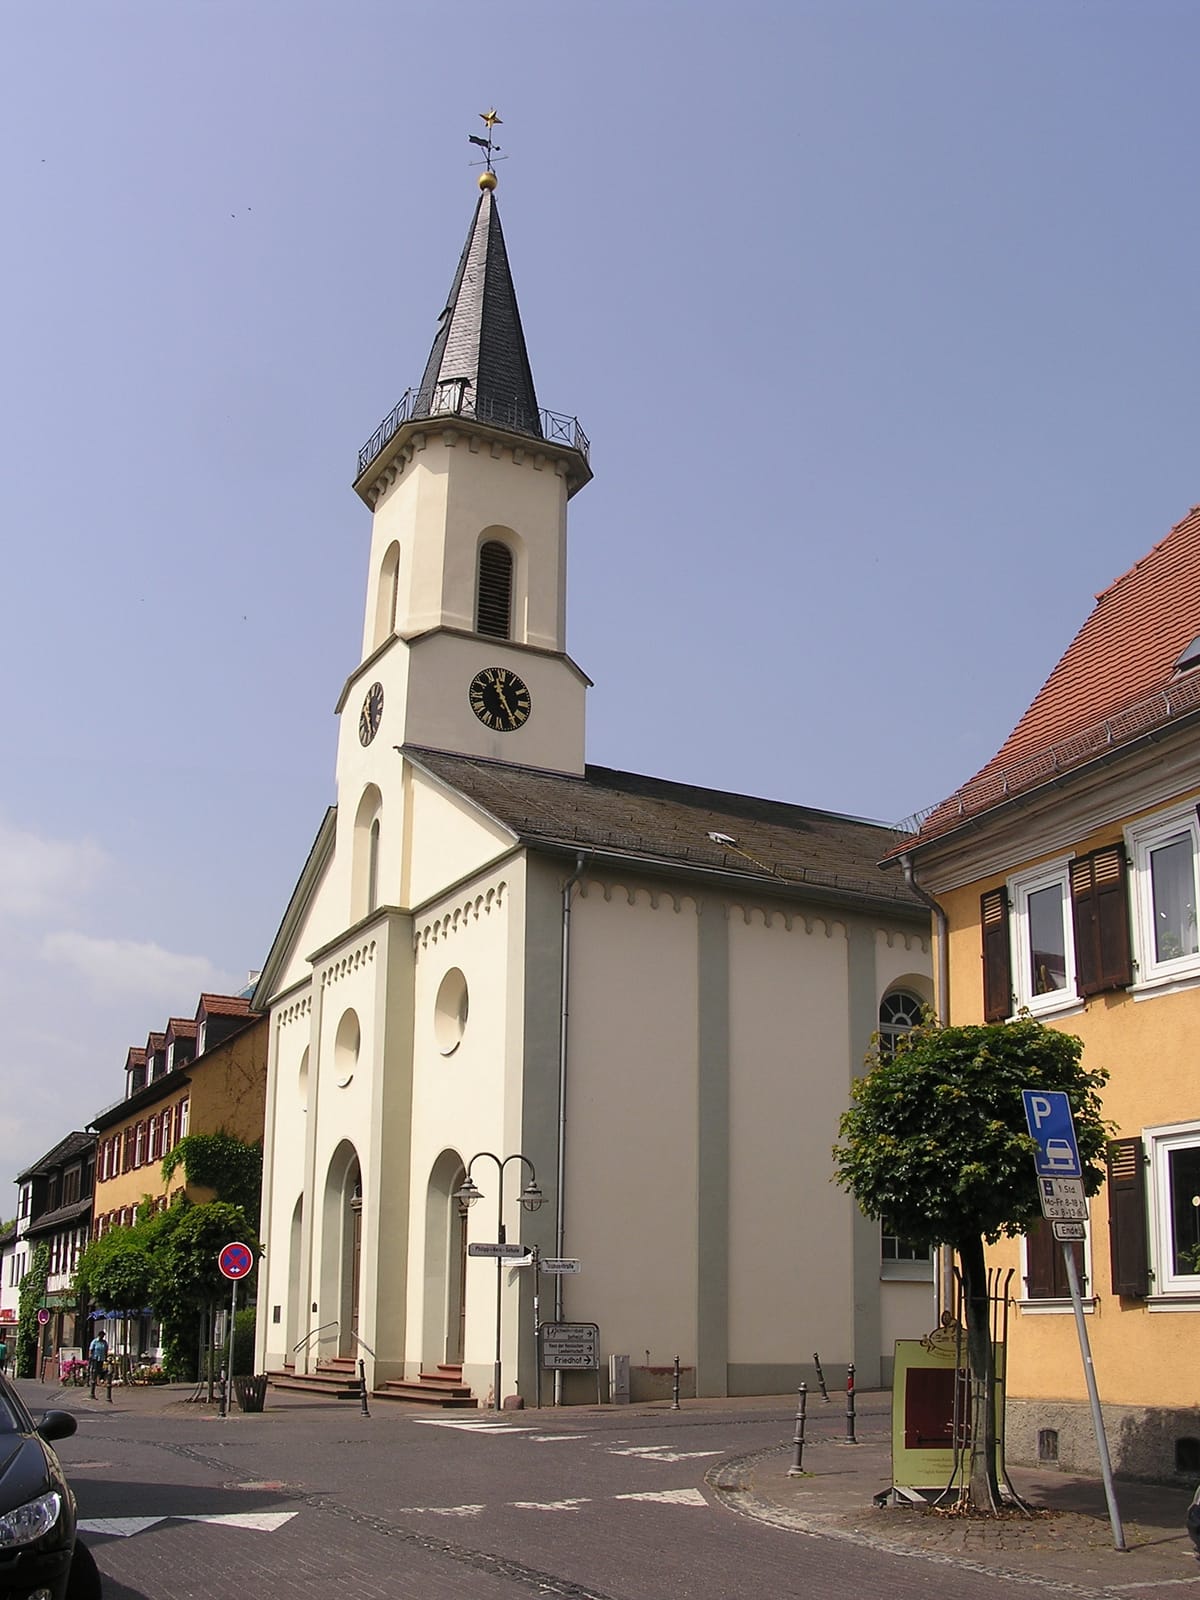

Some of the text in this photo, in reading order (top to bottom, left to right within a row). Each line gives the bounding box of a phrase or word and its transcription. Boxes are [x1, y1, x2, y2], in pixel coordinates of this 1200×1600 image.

[1031, 1096, 1052, 1129] P
[1044, 1197, 1063, 1207] Mo-Fr
[554, 1356, 583, 1365] Friedhof
